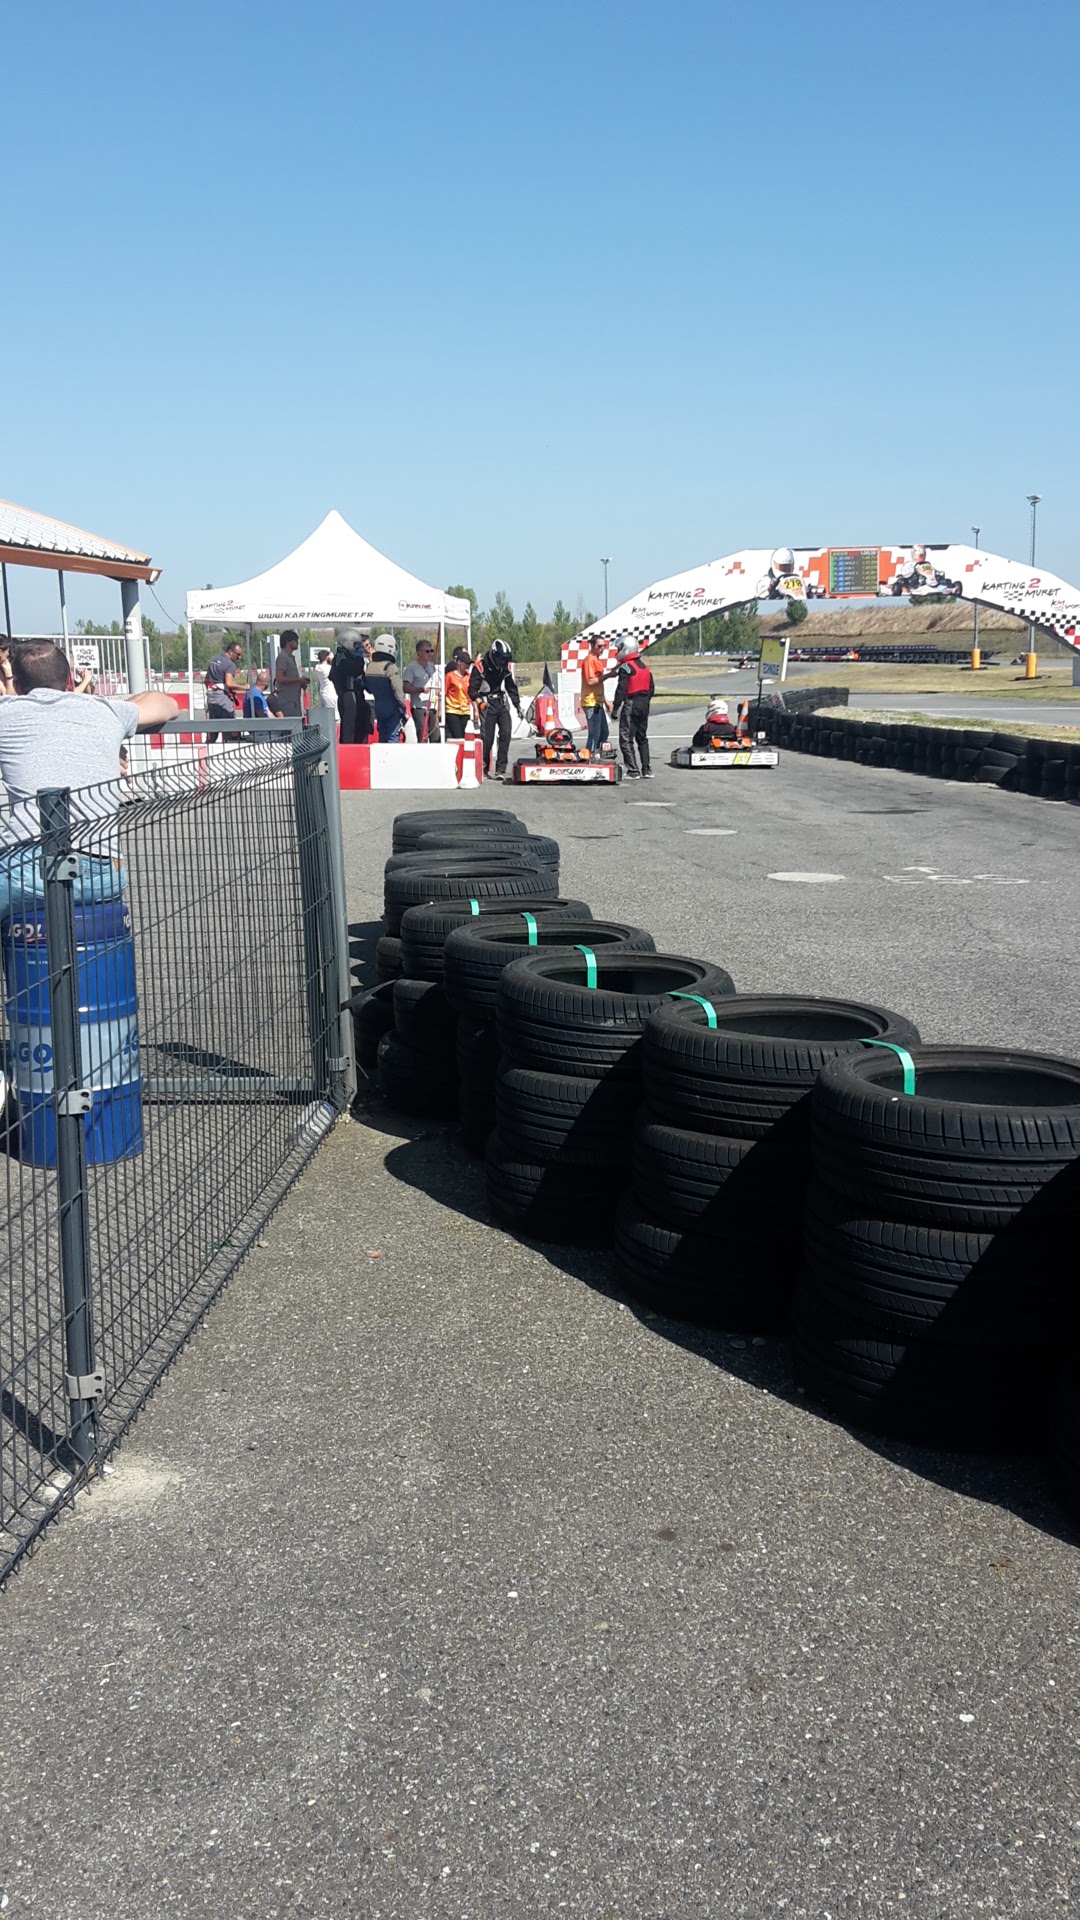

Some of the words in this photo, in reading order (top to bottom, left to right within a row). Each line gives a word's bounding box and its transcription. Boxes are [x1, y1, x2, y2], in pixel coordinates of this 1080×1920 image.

[981, 582, 1025, 593] KARTING
[1028, 577, 1041, 589] 2
[648, 591, 692, 602] KARTING
[693, 587, 705, 598] 2
[1024, 588, 1061, 598] MURET
[690, 597, 725, 607] MURET
